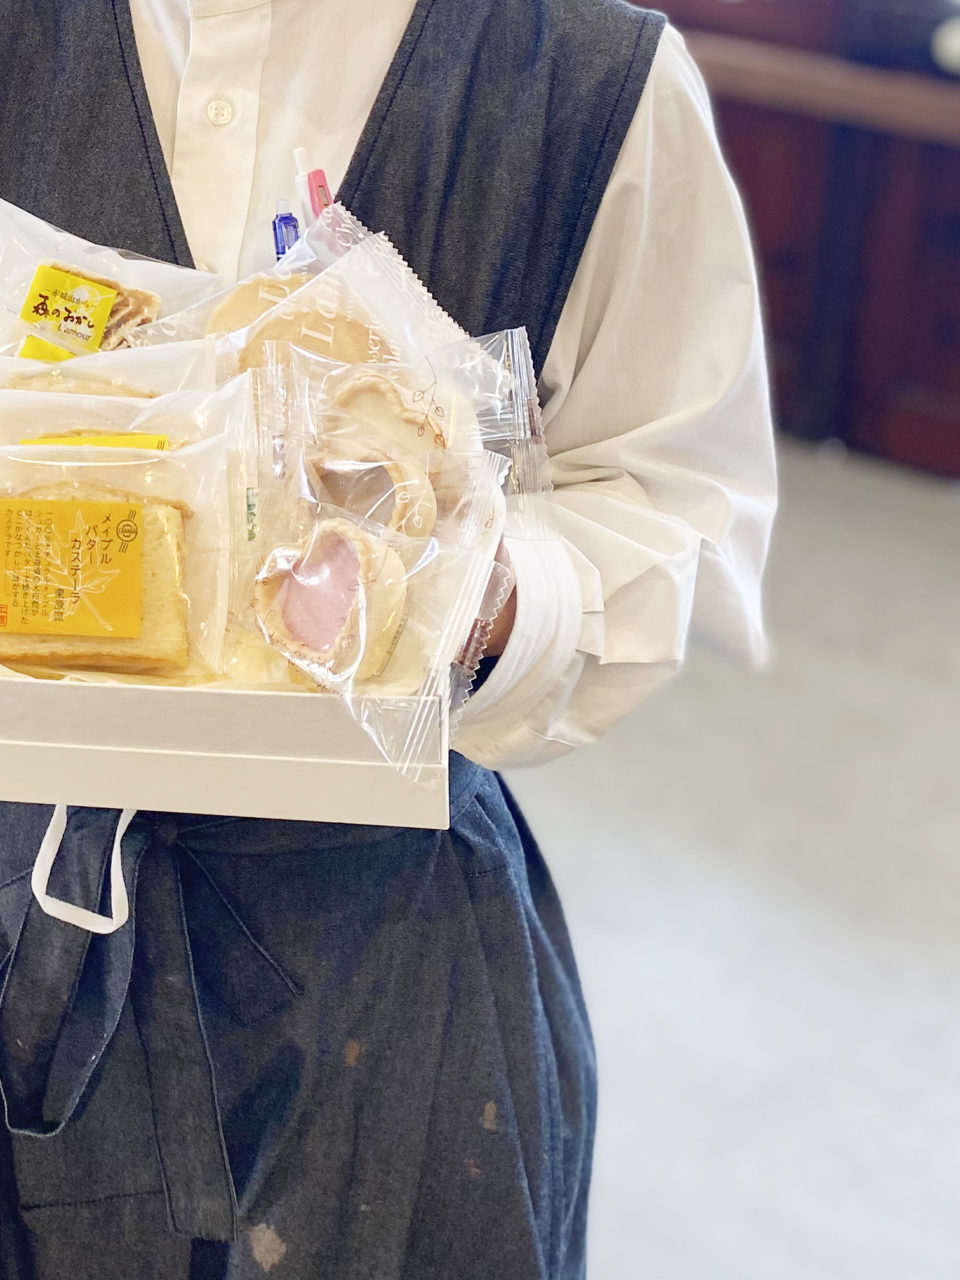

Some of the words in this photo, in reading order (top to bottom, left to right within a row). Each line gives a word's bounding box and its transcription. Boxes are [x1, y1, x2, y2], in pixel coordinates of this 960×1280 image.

[85, 524, 99, 565] バター
[100, 512, 114, 565] メイプル
[69, 538, 82, 605] カステーラ
